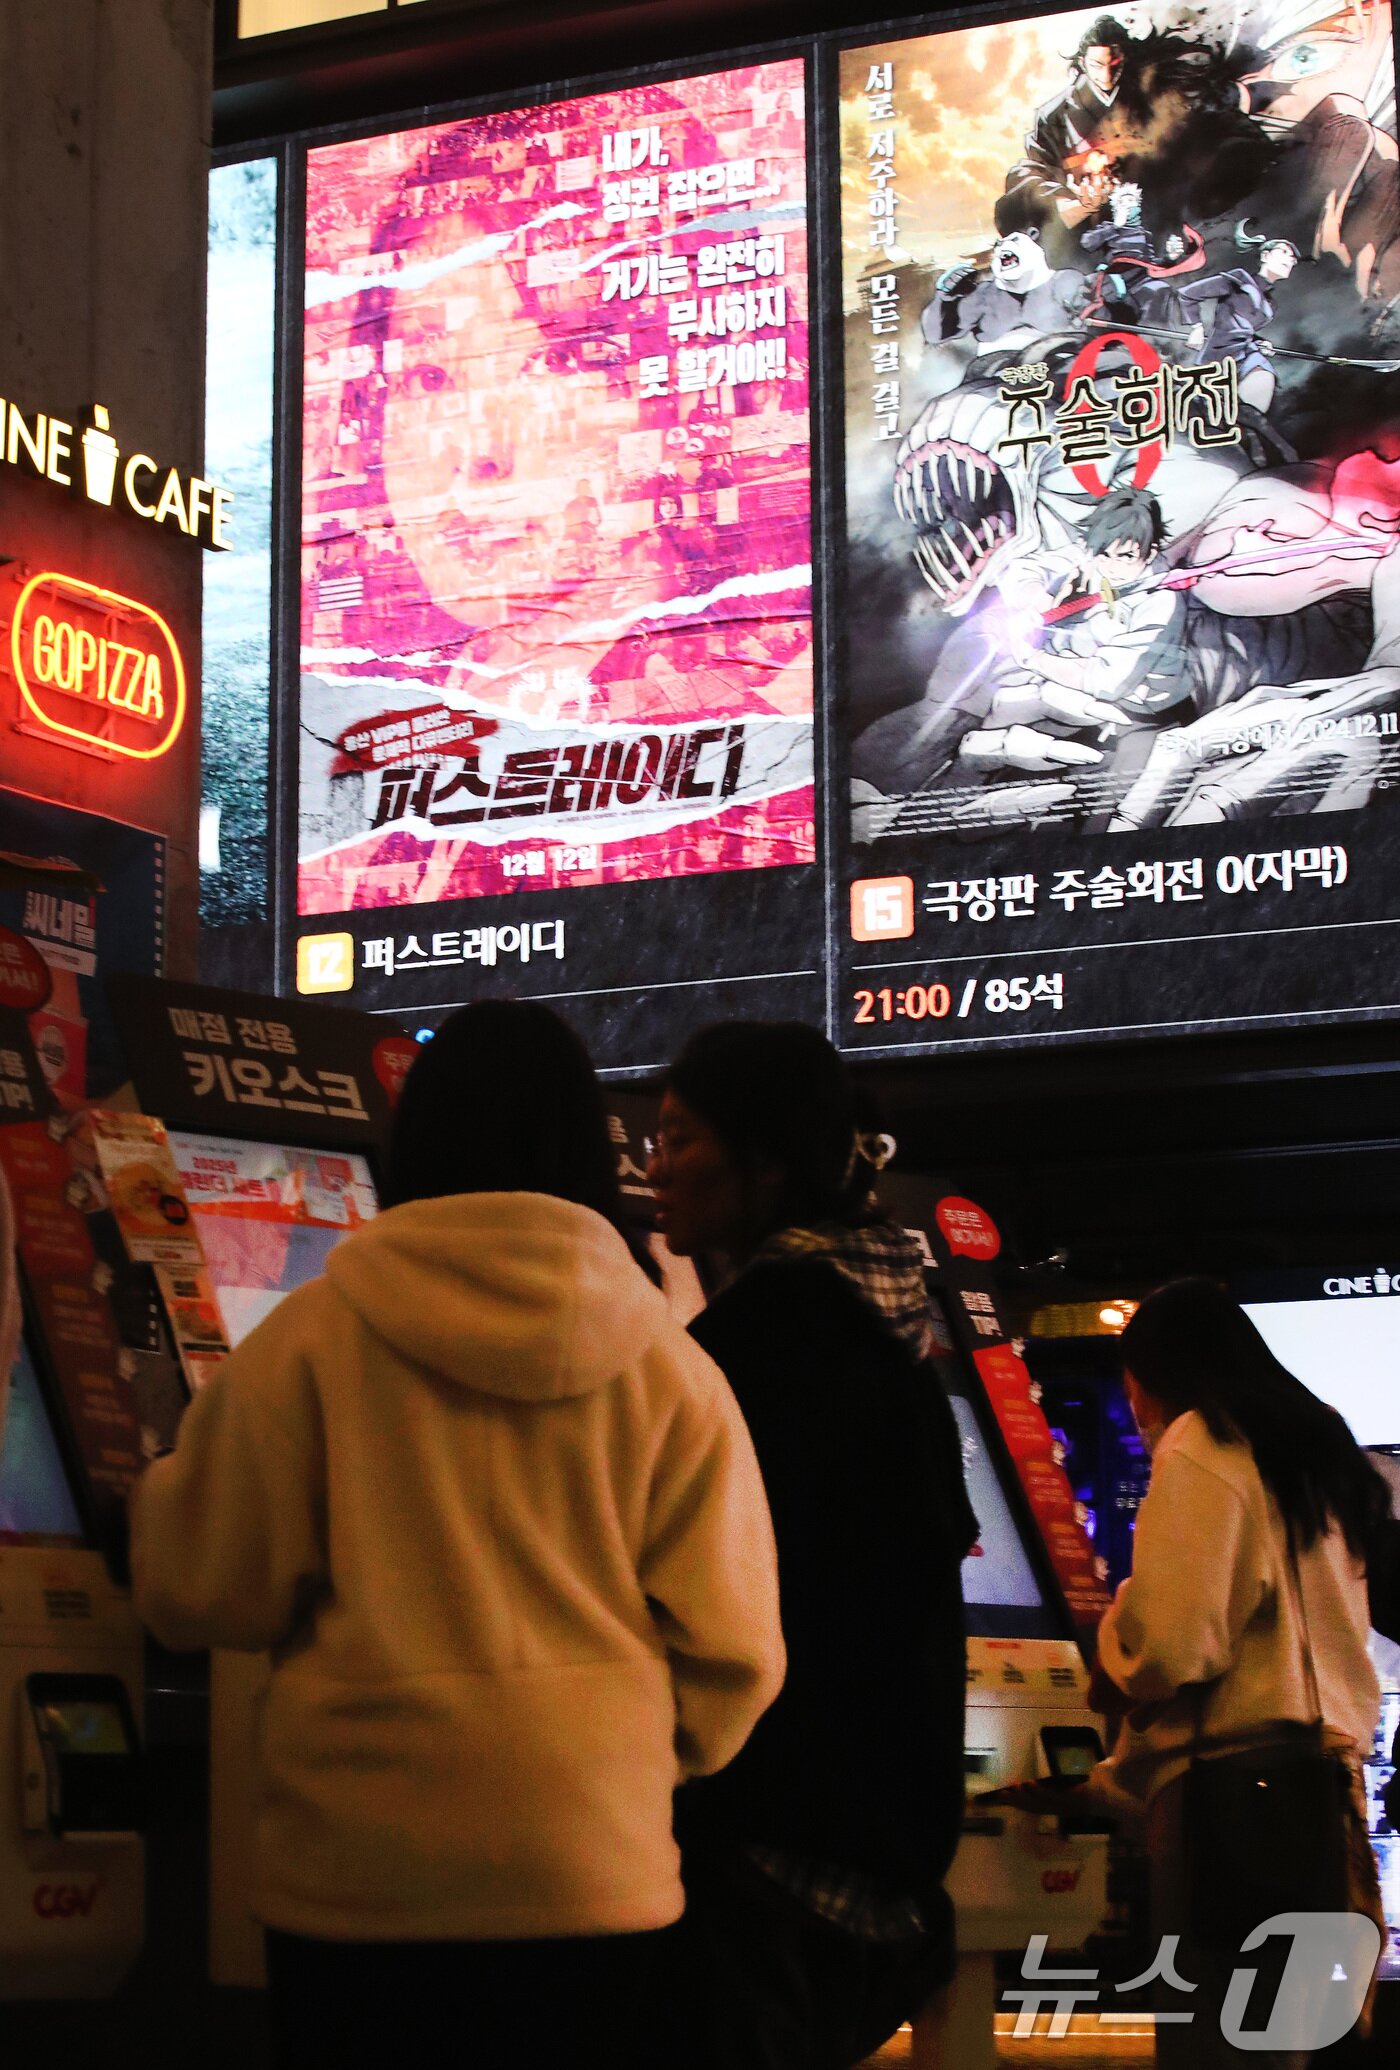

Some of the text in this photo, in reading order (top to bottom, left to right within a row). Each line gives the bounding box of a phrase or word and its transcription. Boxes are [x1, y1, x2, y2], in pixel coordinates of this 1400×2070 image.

[602, 175, 661, 223] 정권
[601, 234, 785, 302] 거기는 완전히
[864, 62, 903, 441] 서로 저주하라 모든 걸 걸고
[667, 285, 787, 342] 무사하지
[638, 355, 669, 399] 못
[998, 356, 1242, 472] 주술회전
[0, 397, 236, 551] INE CAFE
[33, 615, 164, 720] GOPIZZA
[371, 724, 746, 829] 퍼스트레이디
[501, 846, 598, 878] 12월 12일
[863, 845, 1348, 931] 15 극장판 주술회전 0(자막)
[307, 919, 566, 984] 12 퍼스트레이디
[853, 983, 950, 1023] 21:00
[984, 972, 1064, 1013] 85석
[167, 1006, 299, 1055] 매점 전용
[182, 1051, 371, 1122] 키오스크
[1323, 1276, 1374, 1296] CINE
[33, 1882, 101, 1920] CGV
